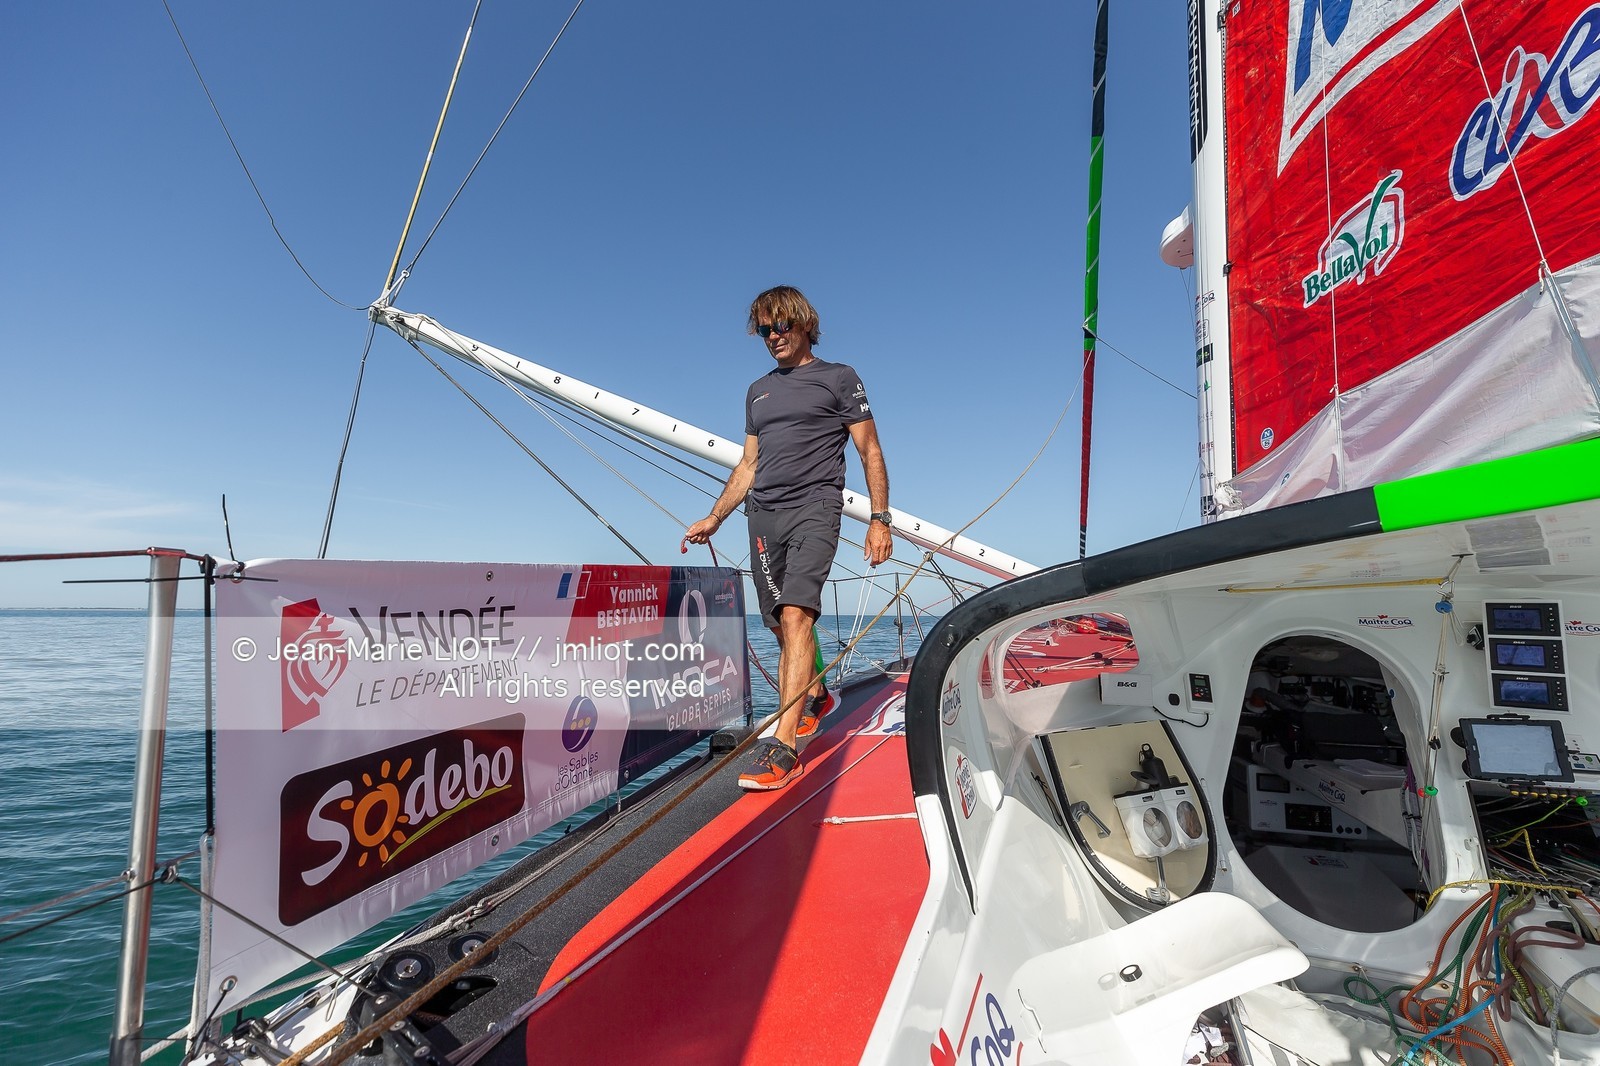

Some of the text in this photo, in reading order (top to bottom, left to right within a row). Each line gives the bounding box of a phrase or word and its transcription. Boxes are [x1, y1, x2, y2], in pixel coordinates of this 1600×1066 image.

[1304, 175, 1398, 304] BellaVol
[553, 376, 562, 384] 8
[631, 407, 640, 416] 7
[707, 439, 715, 448] 6
[847, 496, 854, 504] 4
[914, 523, 921, 531] 3
[978, 548, 986, 557] 2
[610, 583, 659, 604] Yannick
[597, 605, 659, 629] BESTAVEN
[1391, 618, 1414, 626] CoQ
[348, 596, 516, 663] VENDÉE
[356, 657, 518, 707] LE DÉPARTEMENT
[667, 687, 732, 732] GLOBE SERIES
[569, 751, 599, 772] Sables
[301, 739, 514, 886] Sodebo
